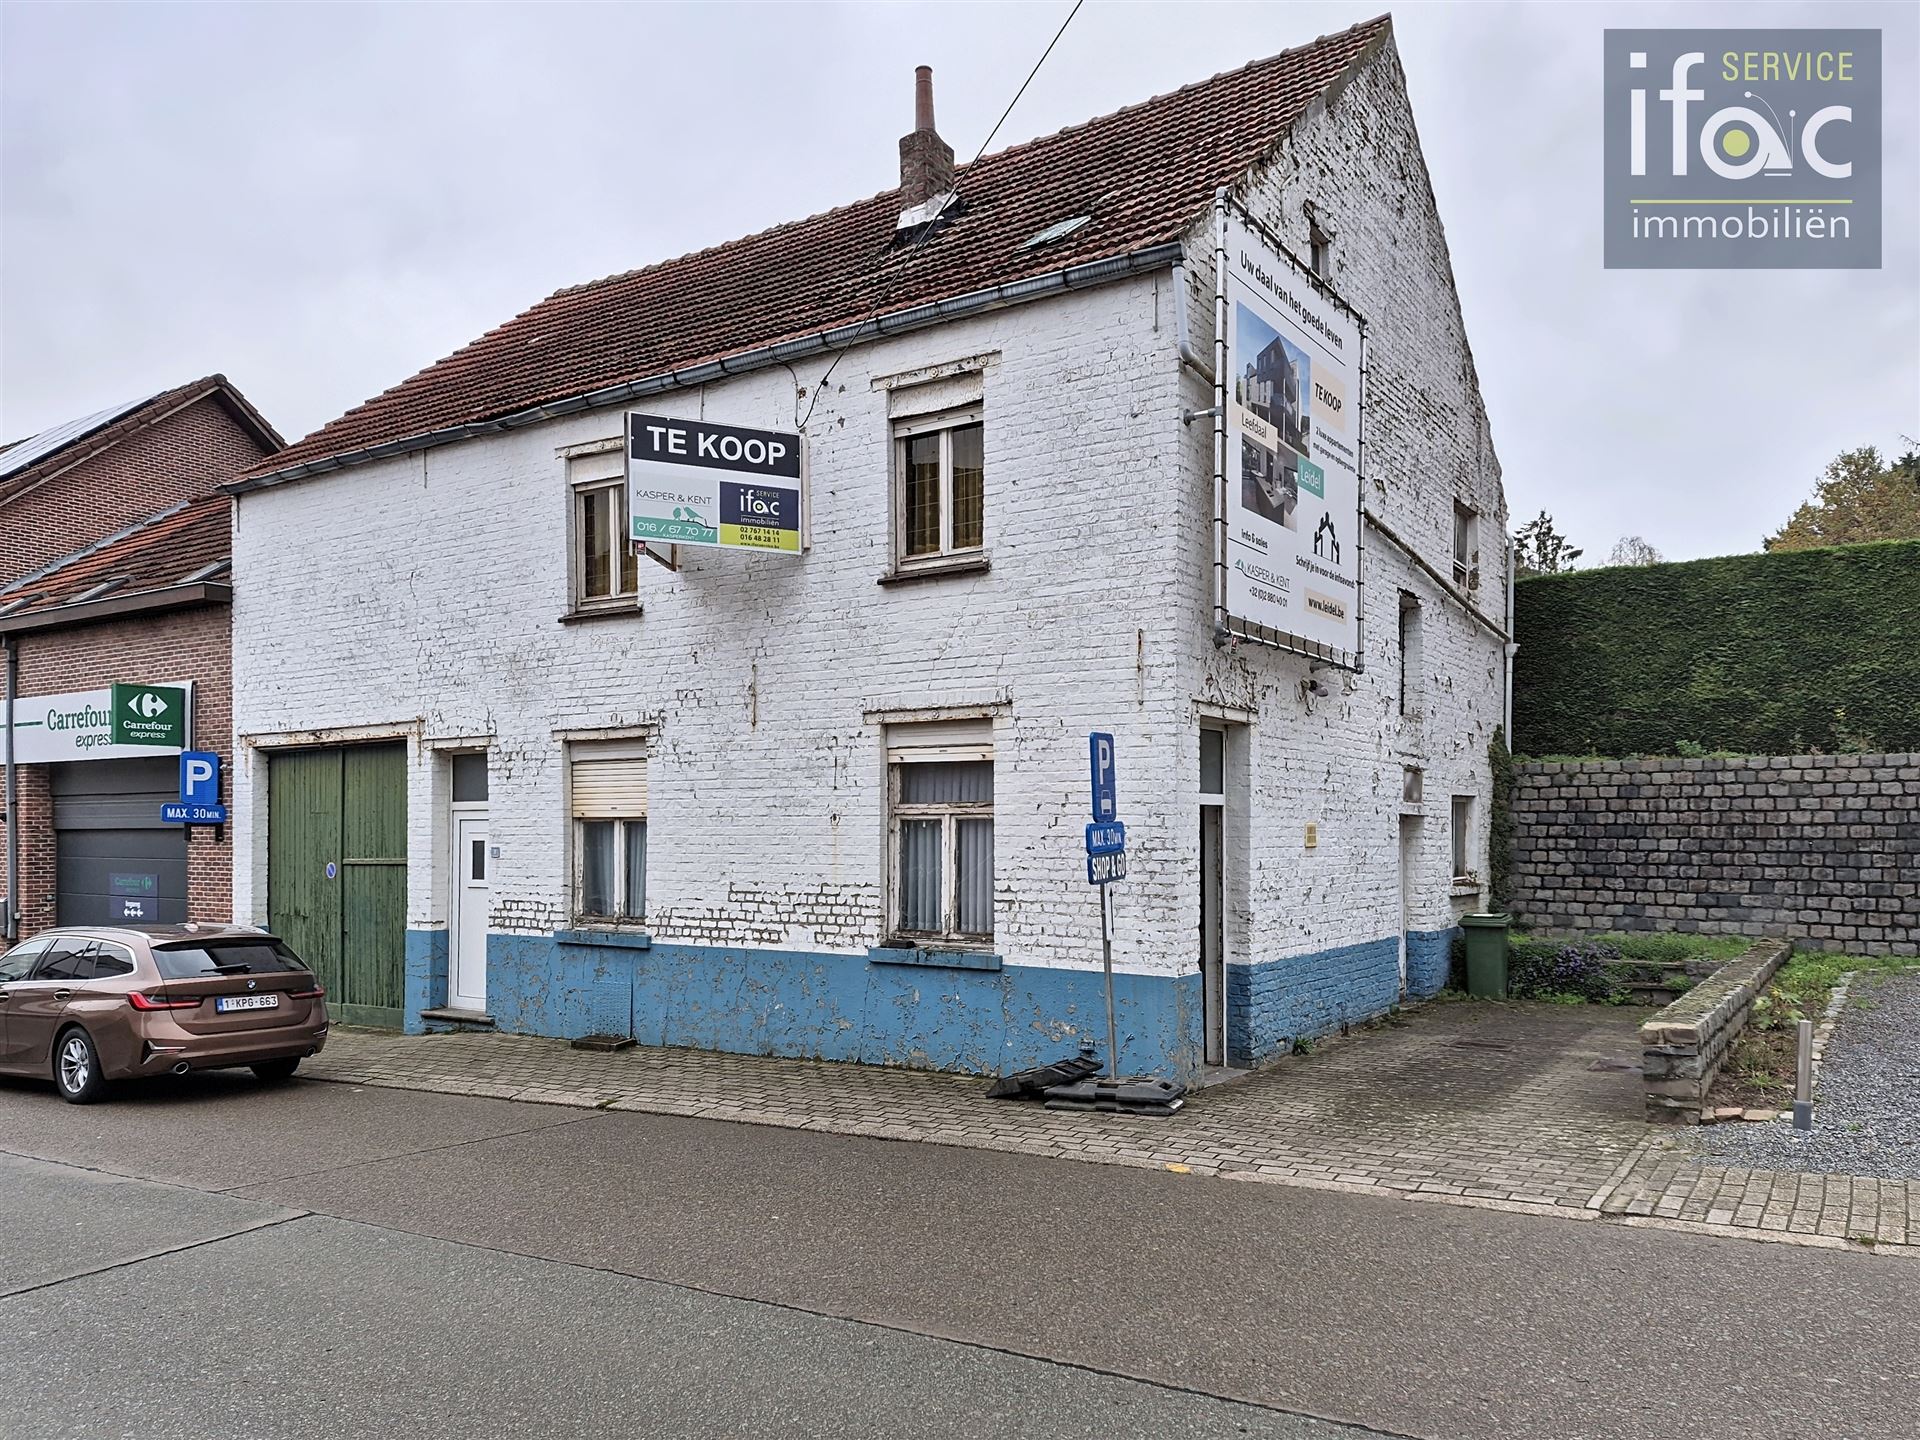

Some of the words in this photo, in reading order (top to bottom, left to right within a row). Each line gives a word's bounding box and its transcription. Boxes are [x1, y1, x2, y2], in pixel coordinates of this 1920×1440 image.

[1241, 250, 1255, 276] Uw
[1256, 264, 1272, 292] daal
[1274, 282, 1288, 305] van
[1289, 290, 1301, 316] het
[1302, 307, 1324, 334] goede
[1324, 321, 1342, 350] leven
[1315, 382, 1323, 401] TE
[1324, 388, 1342, 412] KOOP
[1242, 412, 1267, 439] Leefdaal
[646, 425, 687, 455] TE
[698, 432, 786, 466] KOOP
[1300, 464, 1321, 489] Leidel
[636, 490, 676, 502] KASPER
[678, 494, 686, 503] &
[688, 495, 712, 505] KENT
[740, 488, 780, 516] ifac
[756, 490, 780, 499] SERVICE
[637, 522, 657, 532] 016
[660, 524, 666, 533] /
[668, 525, 682, 534] 67
[685, 526, 698, 536] 70
[702, 528, 714, 537] 77
[740, 526, 748, 534] 02
[1296, 554, 1310, 571] Schrijf
[1246, 563, 1270, 580] KASPER
[1271, 572, 1276, 584] &
[1276, 575, 1290, 589] KENT
[1249, 586, 1258, 598] +32
[1308, 598, 1344, 619] www.leidel.be
[123, 720, 173, 731] Carrefour
[130, 731, 166, 739] express
[1098, 740, 1110, 785] P
[186, 760, 213, 796] P
[166, 808, 190, 818] MAX.
[1092, 856, 1110, 881] SHOP
[1111, 855, 1116, 878] &
[1116, 853, 1126, 876] GO
[225, 996, 277, 1009] 1-KPG-663
